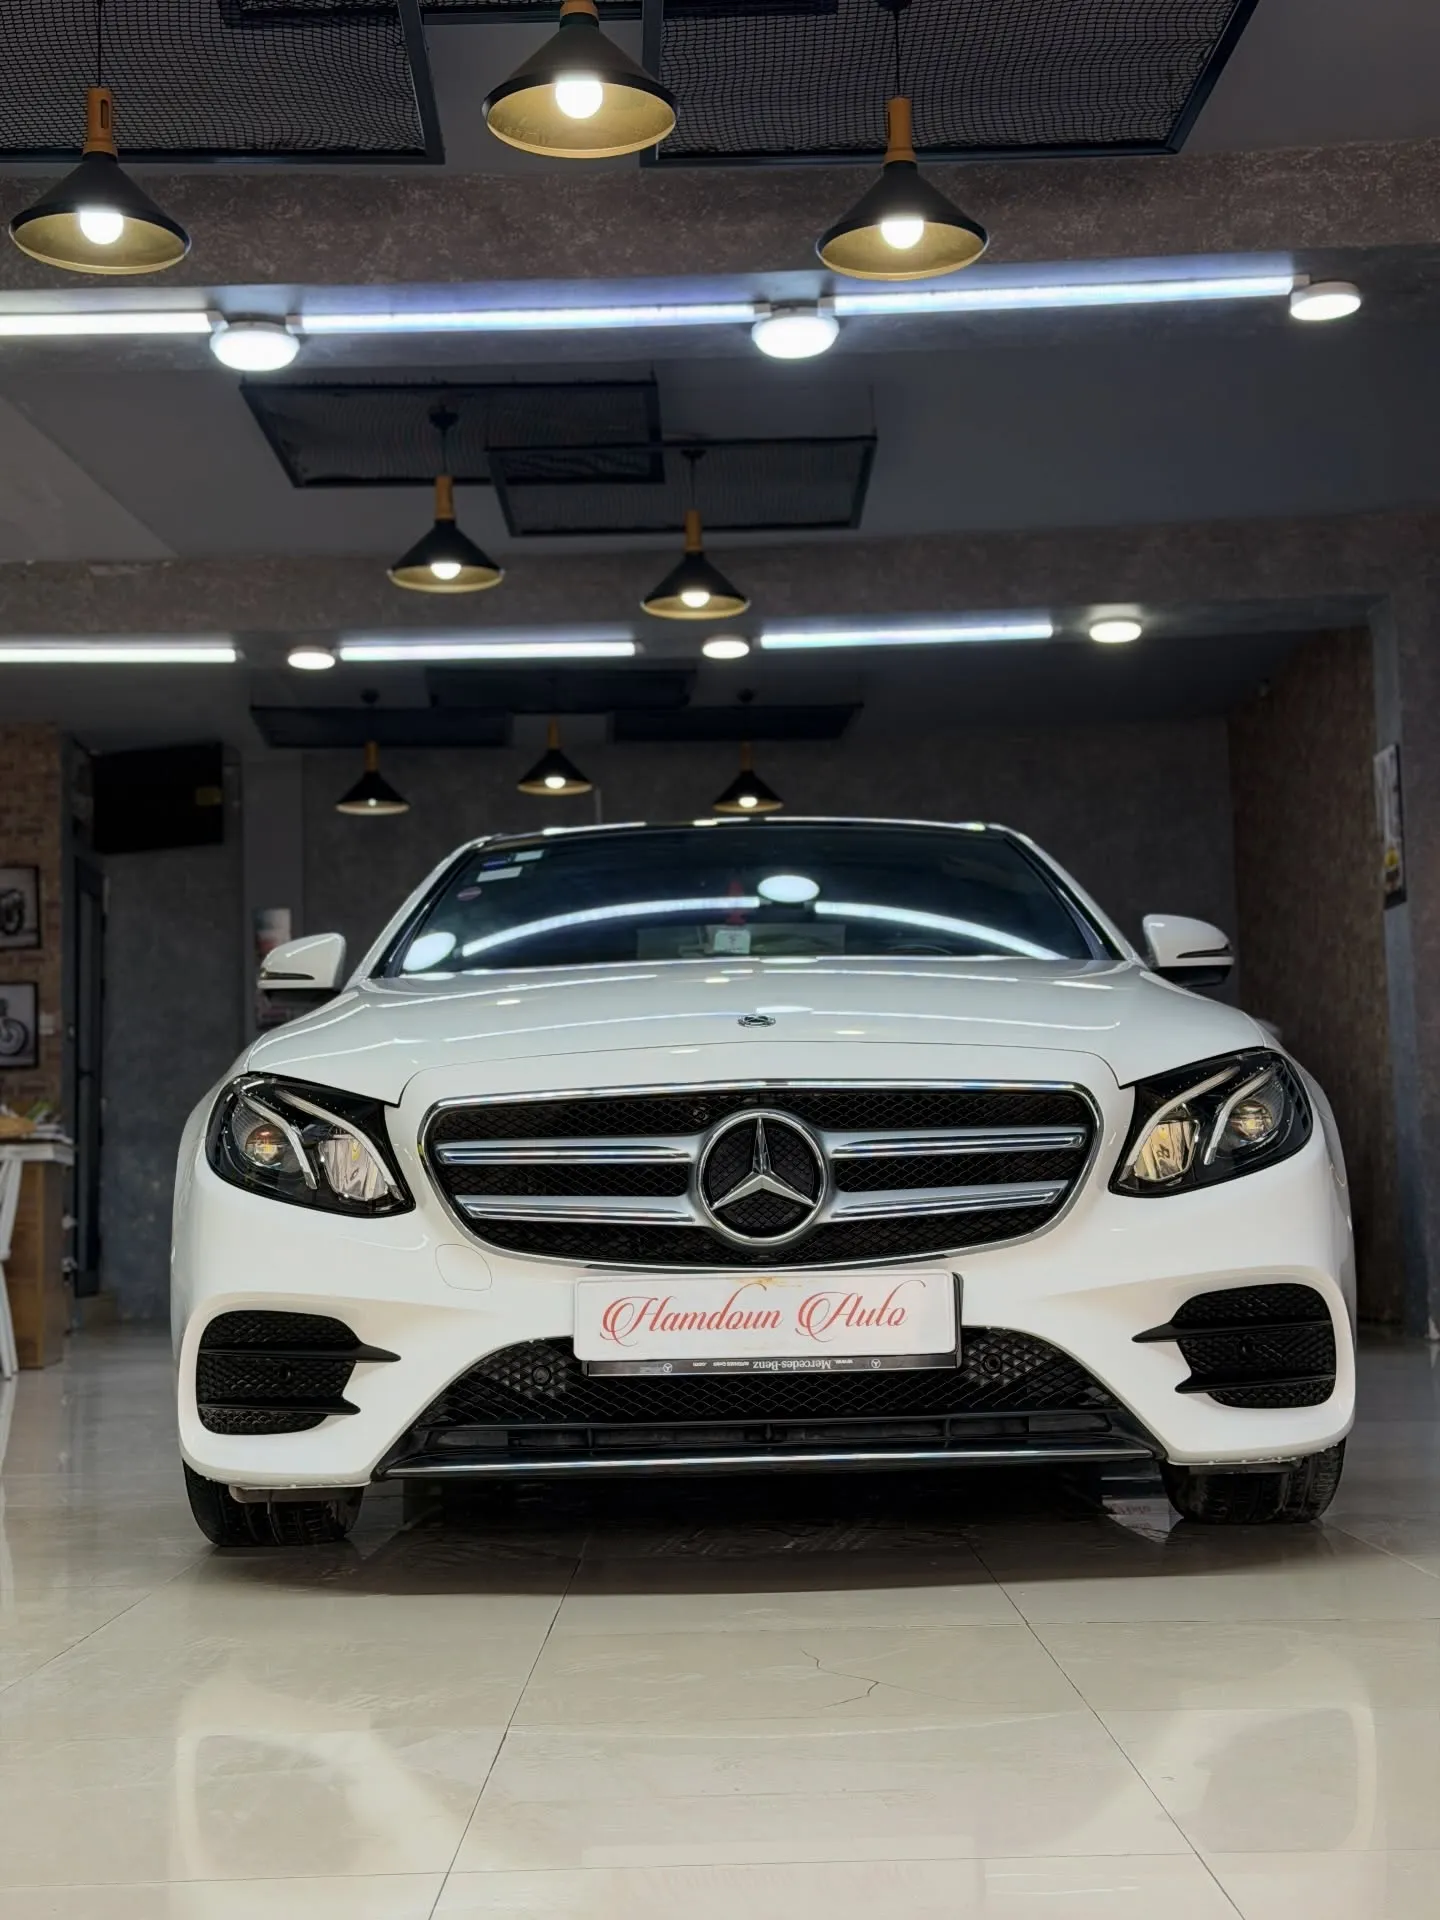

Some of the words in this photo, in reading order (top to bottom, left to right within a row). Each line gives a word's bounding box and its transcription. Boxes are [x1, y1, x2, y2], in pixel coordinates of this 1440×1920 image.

[600, 1283, 783, 1347] Hamdoun
[795, 1279, 927, 1342] Auto
[752, 1359, 831, 1370] Mercedes-Benz
